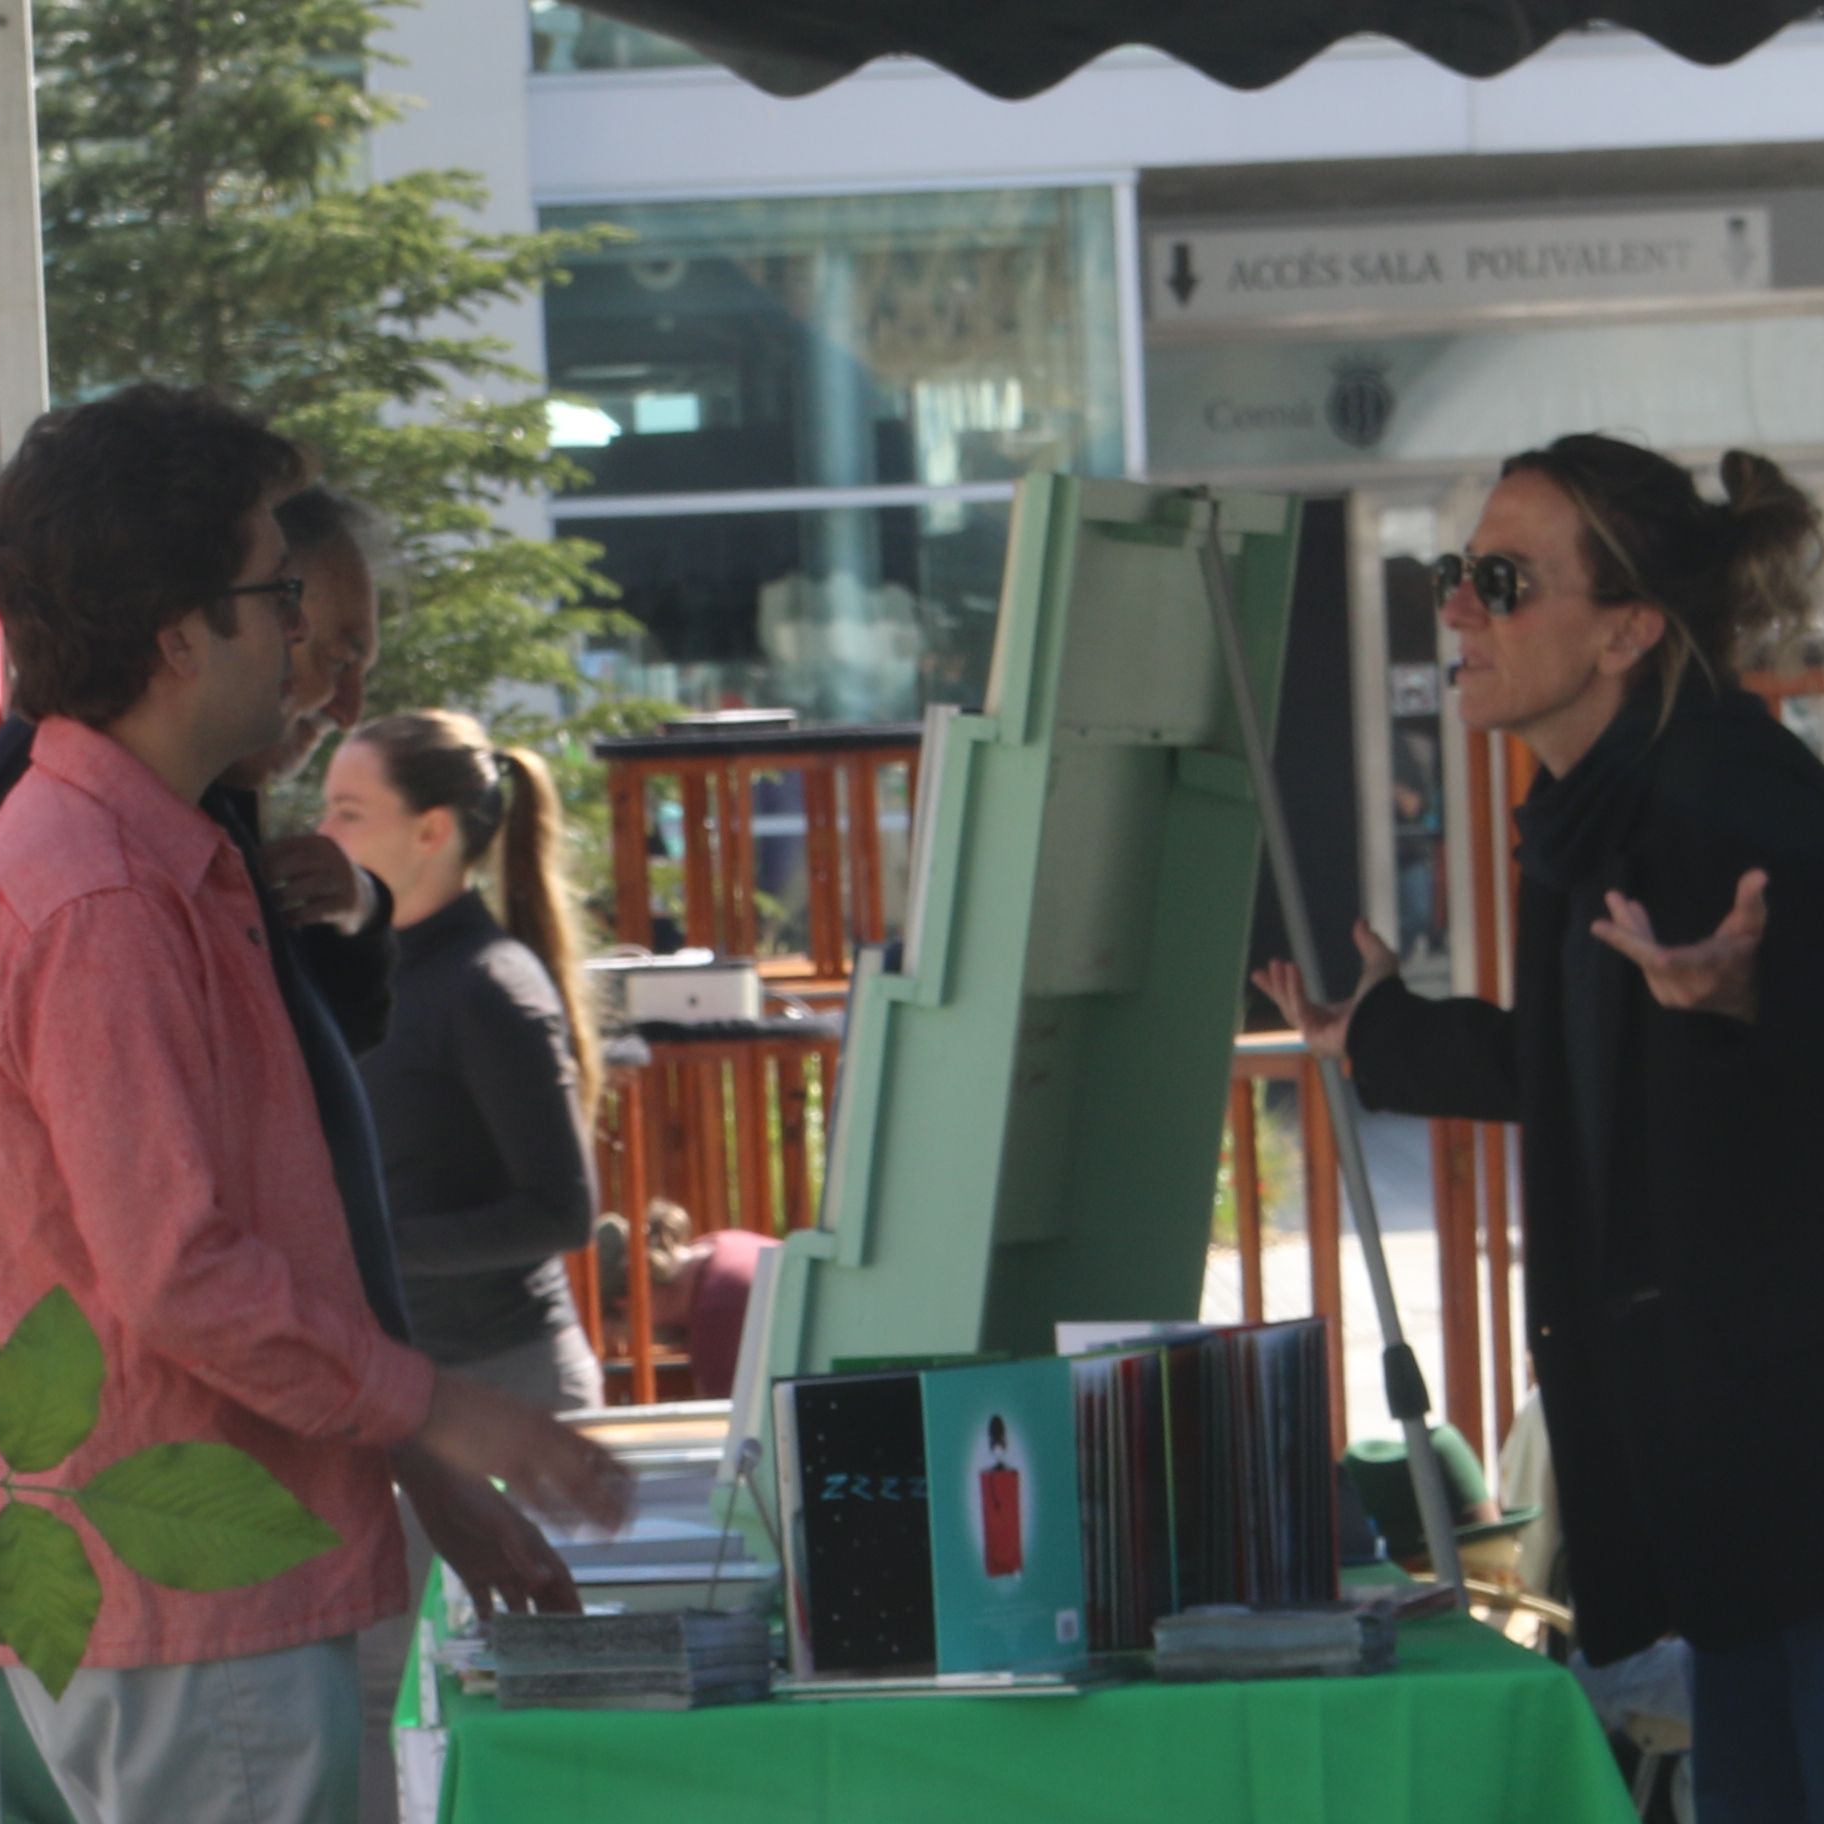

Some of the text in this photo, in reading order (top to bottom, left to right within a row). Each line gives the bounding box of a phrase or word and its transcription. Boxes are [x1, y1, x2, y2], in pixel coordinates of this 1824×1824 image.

[1229, 240, 1693, 292] ACCÉS SALA POLIVALENT
